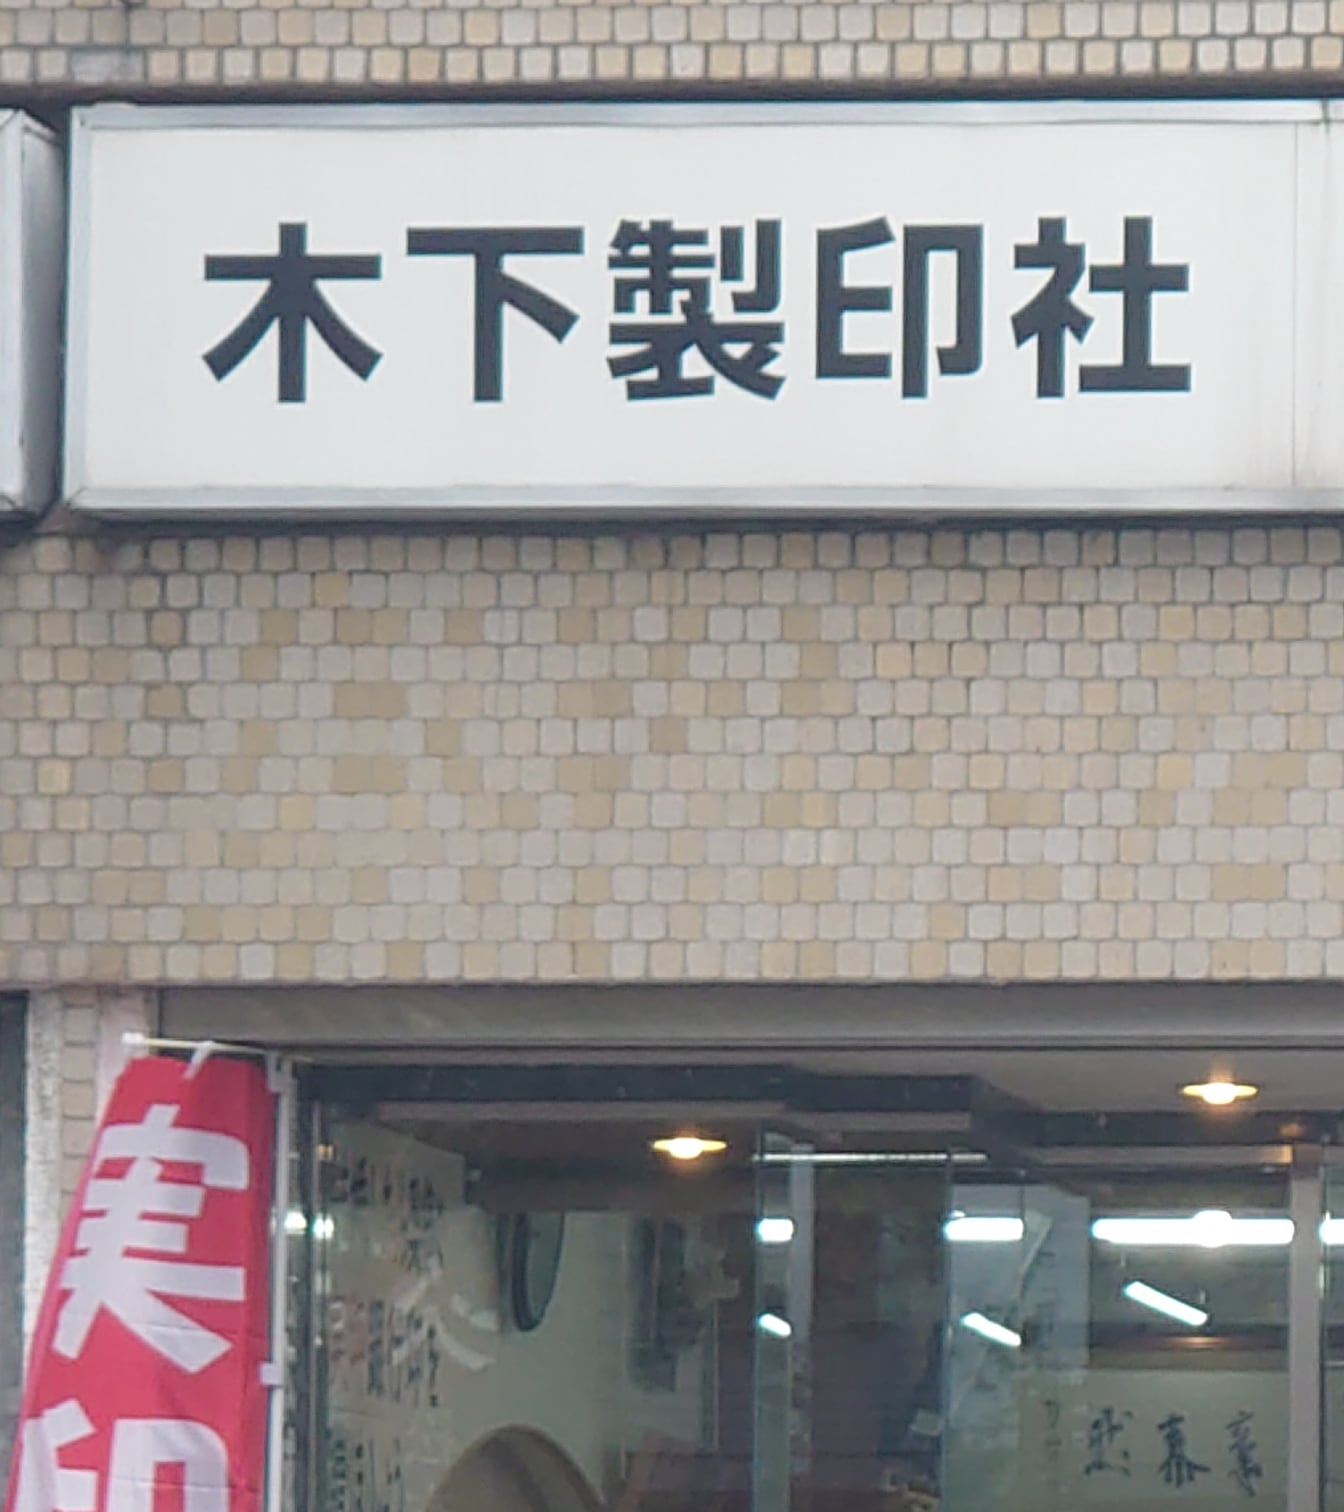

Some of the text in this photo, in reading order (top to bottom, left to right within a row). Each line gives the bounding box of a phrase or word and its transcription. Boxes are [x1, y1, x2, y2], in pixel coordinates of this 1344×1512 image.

[202, 214, 1191, 403] 木下製印社
